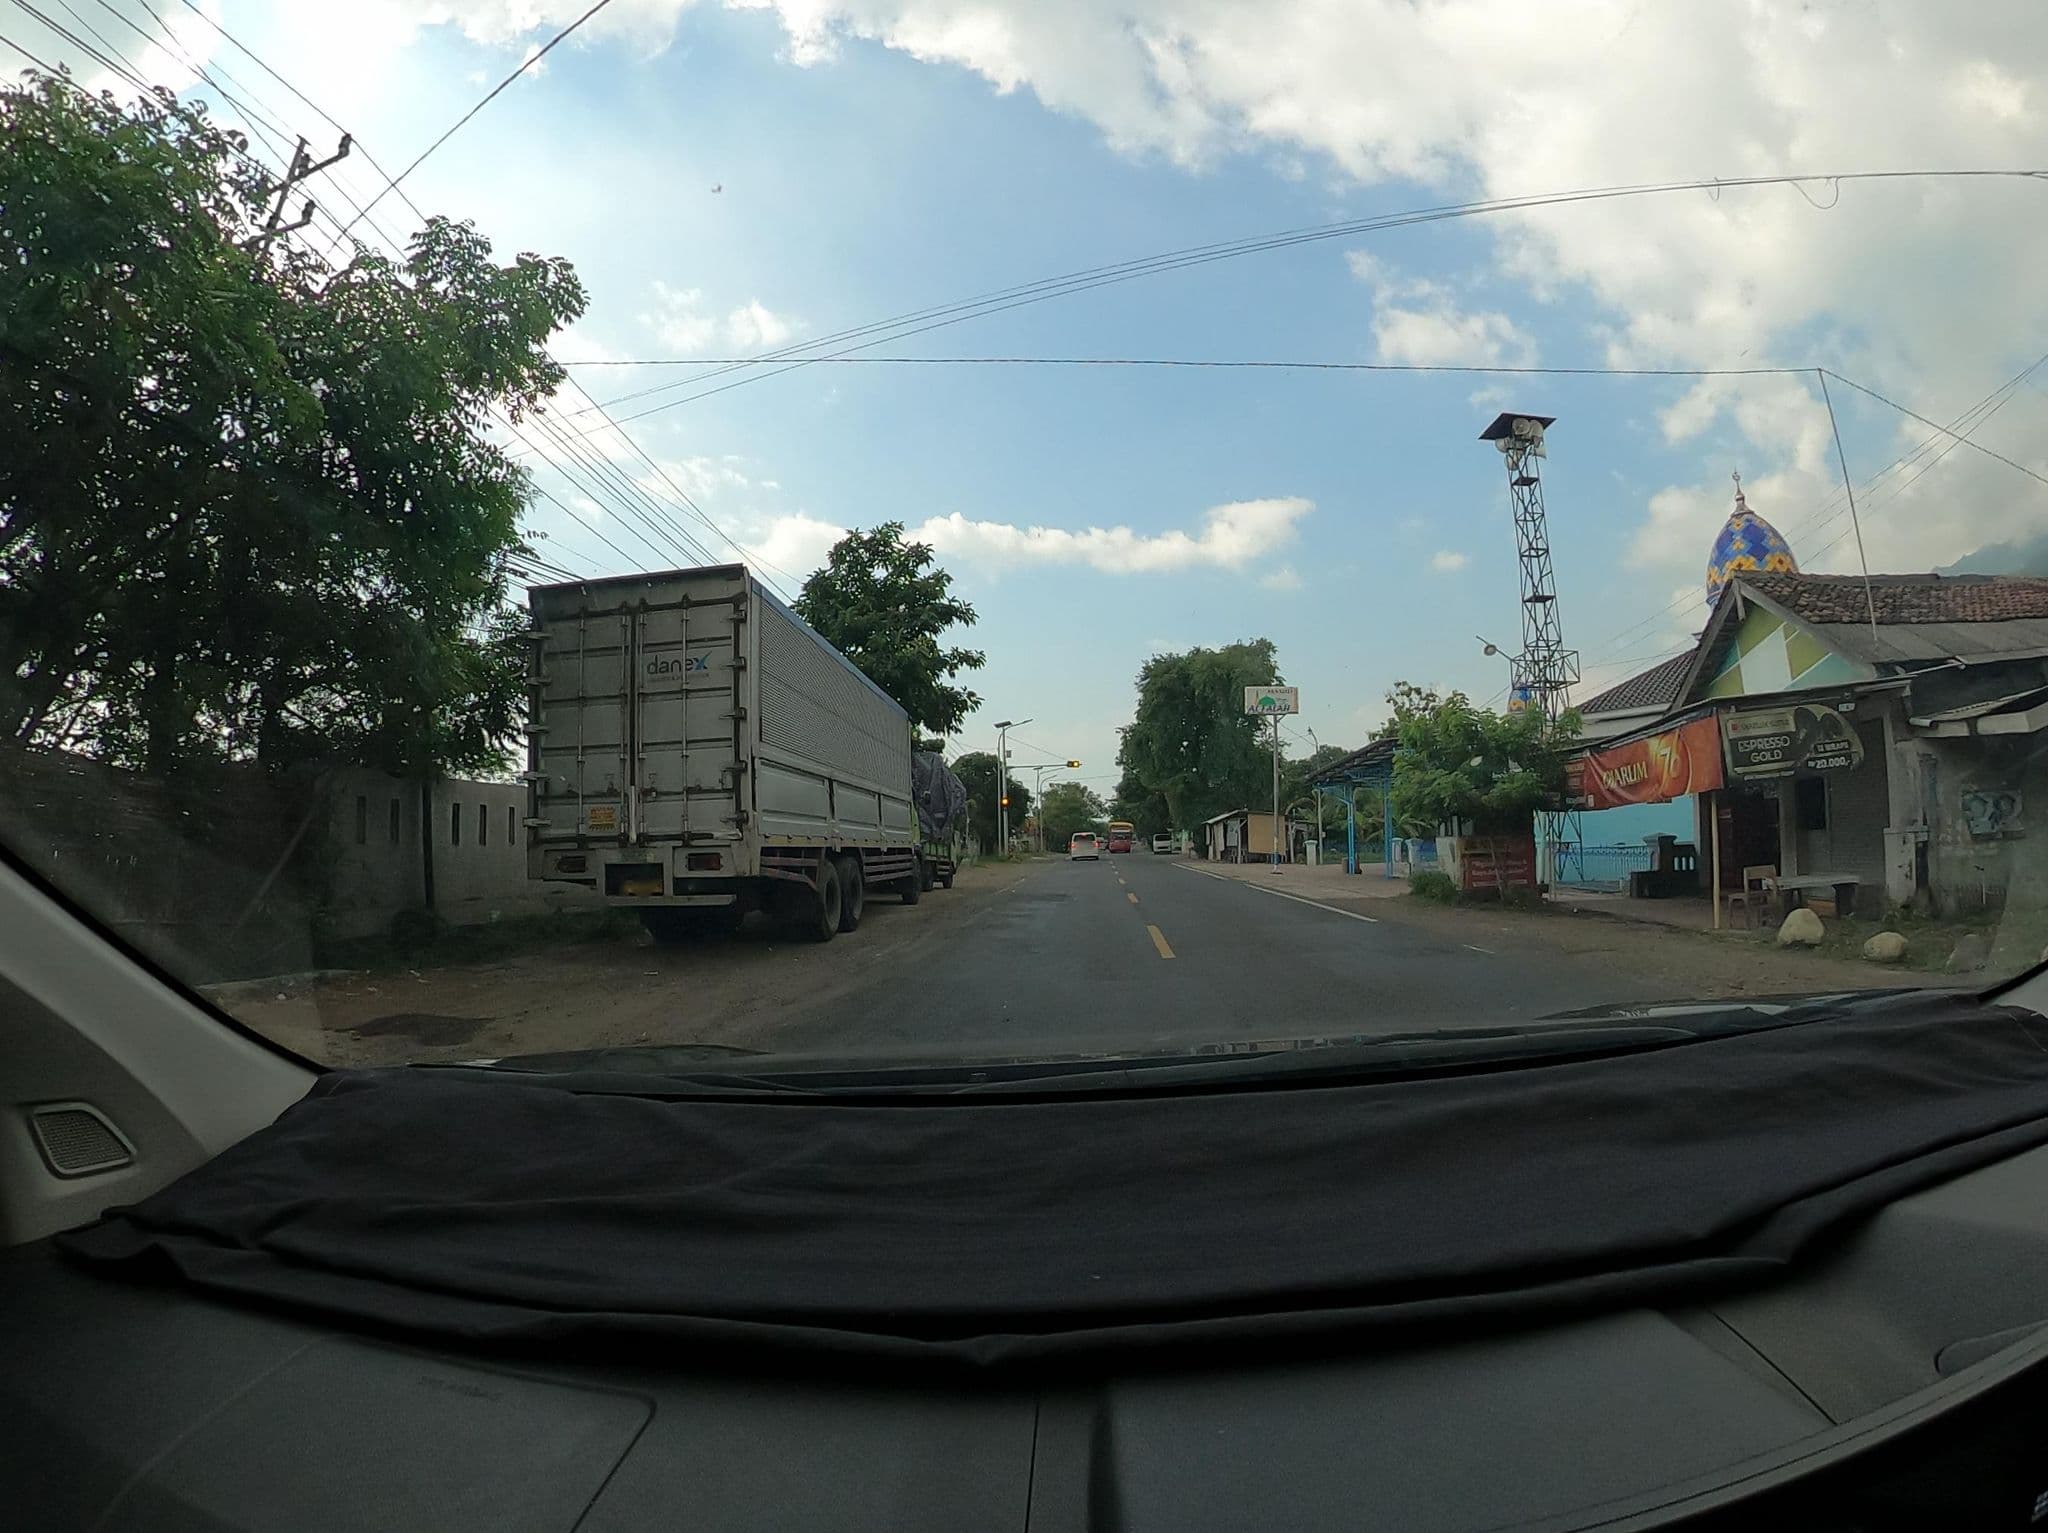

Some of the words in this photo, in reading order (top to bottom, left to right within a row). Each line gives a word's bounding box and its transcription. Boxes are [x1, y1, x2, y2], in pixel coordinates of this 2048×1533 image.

[647, 651, 712, 675] danex
[1738, 735, 1791, 753] ESPRESSO
[1751, 749, 1783, 763] GOLD
